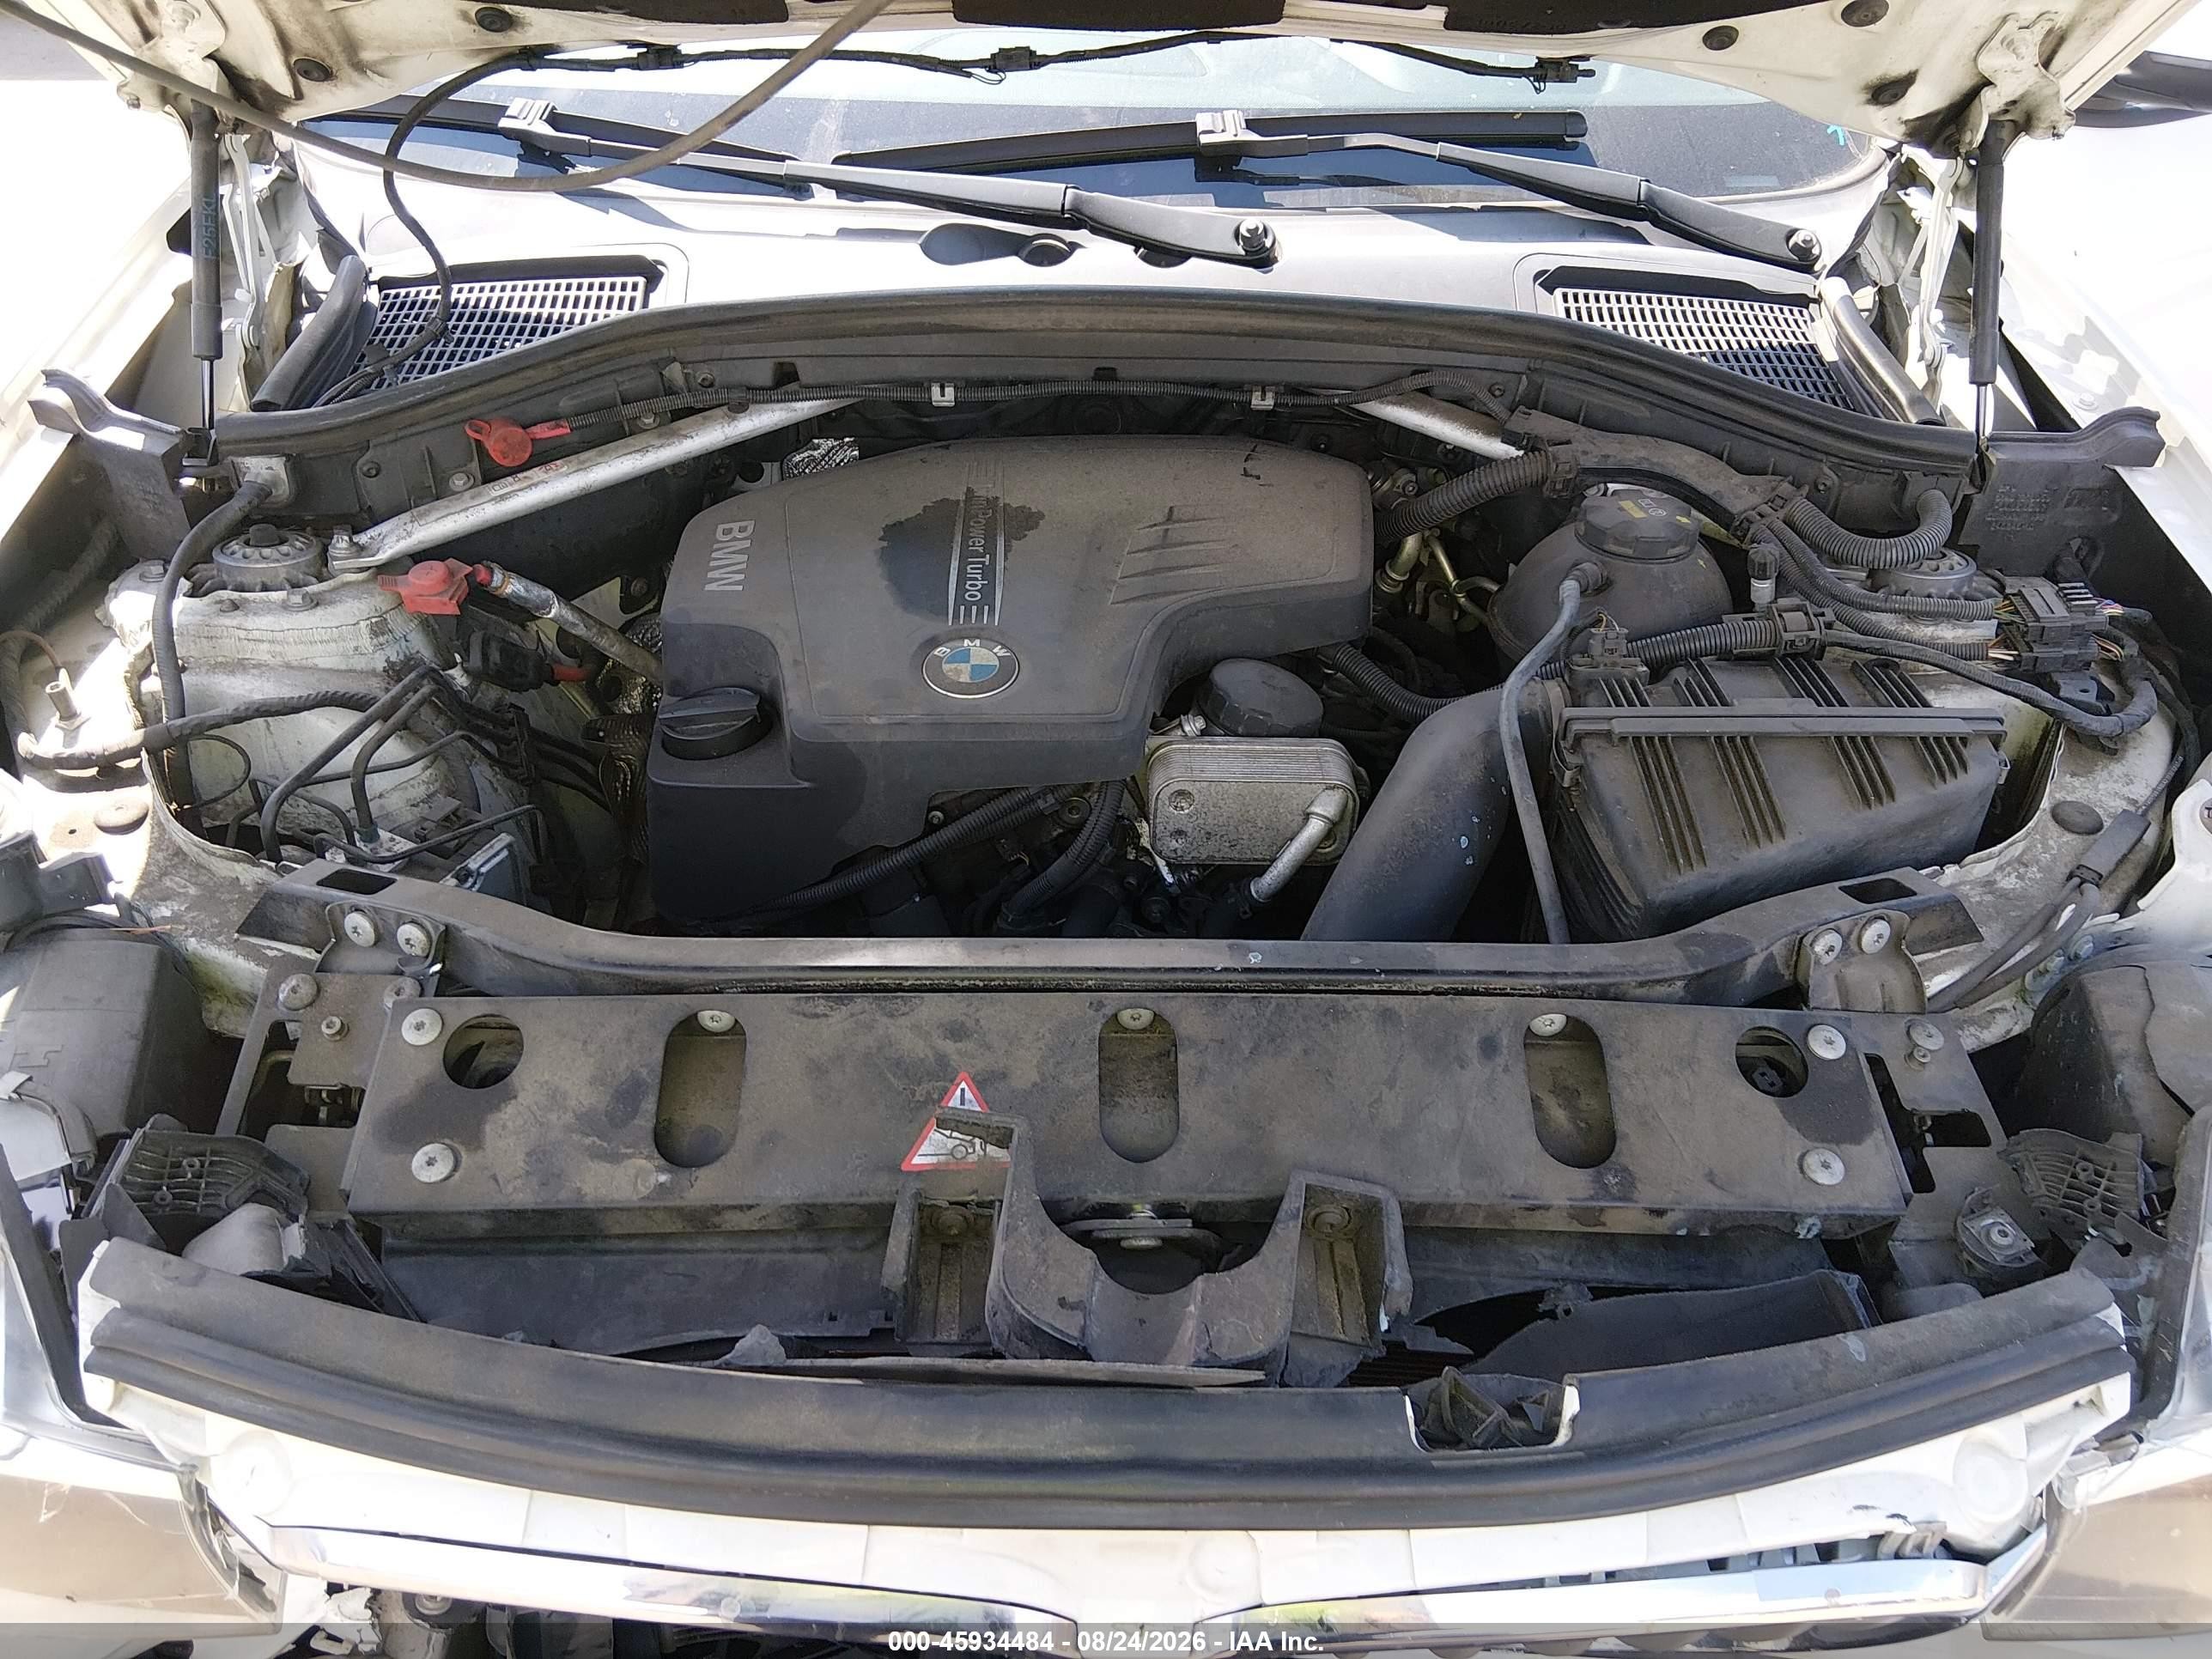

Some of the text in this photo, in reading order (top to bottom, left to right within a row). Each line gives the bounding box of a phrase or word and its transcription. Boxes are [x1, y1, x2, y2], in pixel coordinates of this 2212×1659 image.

[704, 520, 756, 591] BMW
[963, 554, 990, 601] Turbo
[933, 638, 1012, 657] BMW
